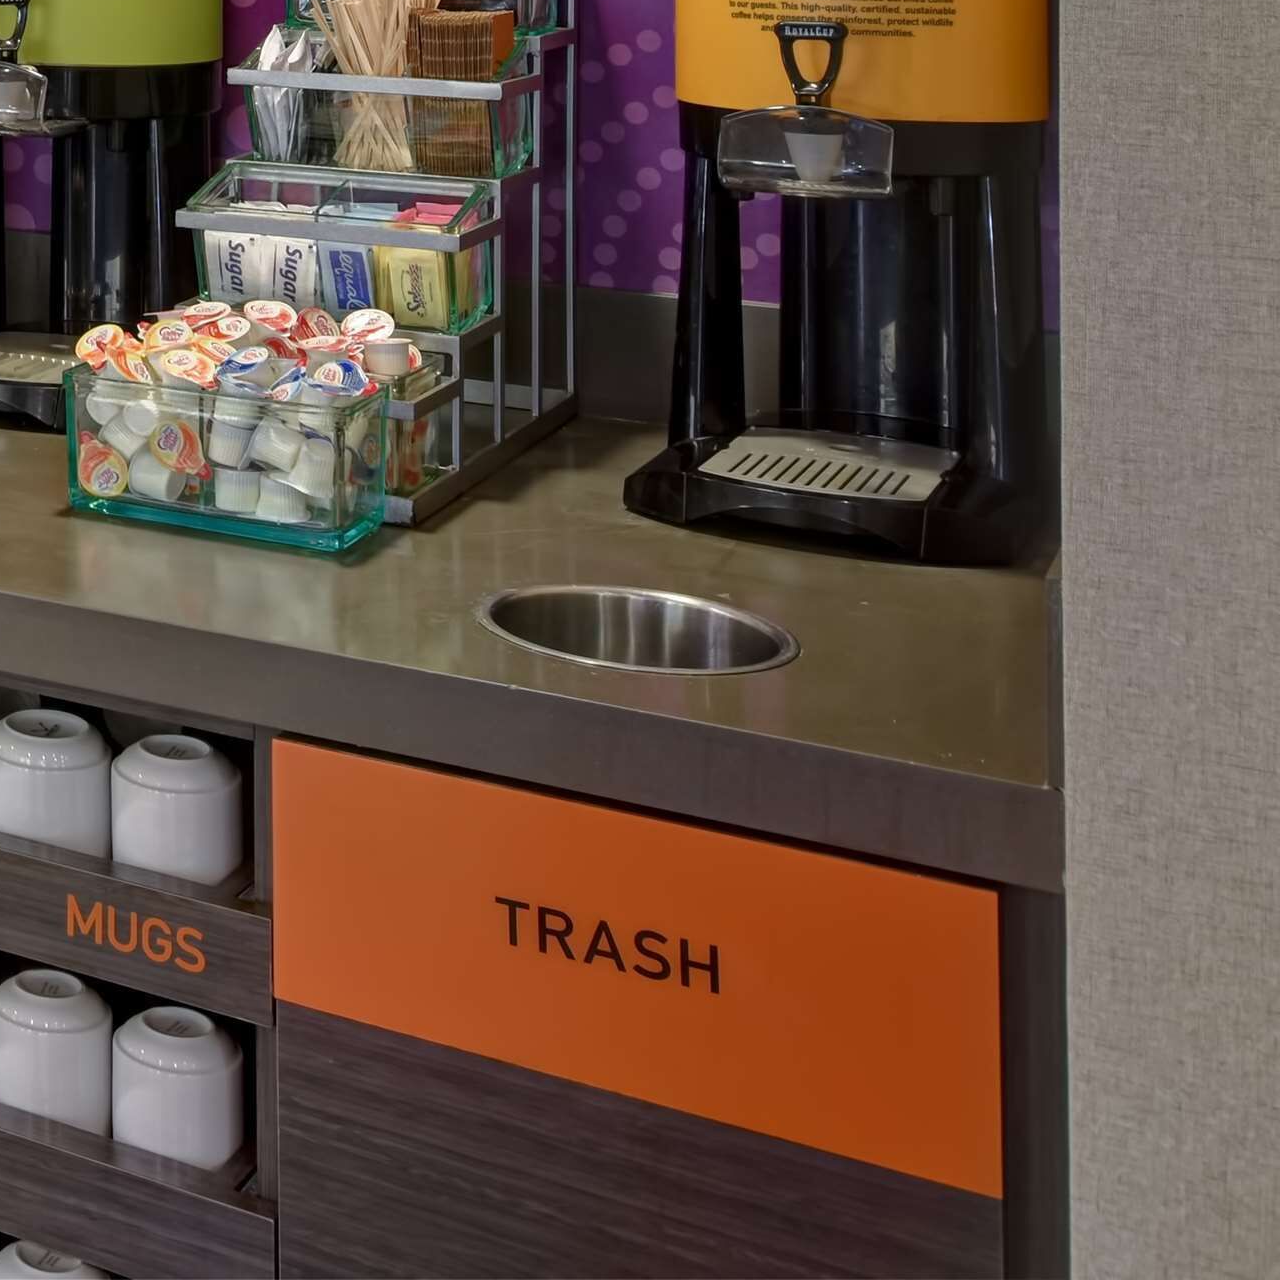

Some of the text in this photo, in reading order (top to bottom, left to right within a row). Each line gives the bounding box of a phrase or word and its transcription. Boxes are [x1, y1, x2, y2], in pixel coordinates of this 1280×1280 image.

[731, 11, 752, 19] coffee
[753, 11, 775, 21] helps
[887, 17, 920, 27] protect
[922, 17, 954, 27] wildlife
[781, 2, 799, 10] This
[904, 6, 957, 15] sustainable
[224, 239, 246, 295] Sugar
[279, 244, 303, 303] Sugar
[335, 249, 369, 310] equal
[66, 894, 207, 974] MUGS
[494, 896, 721, 995] TRASH
